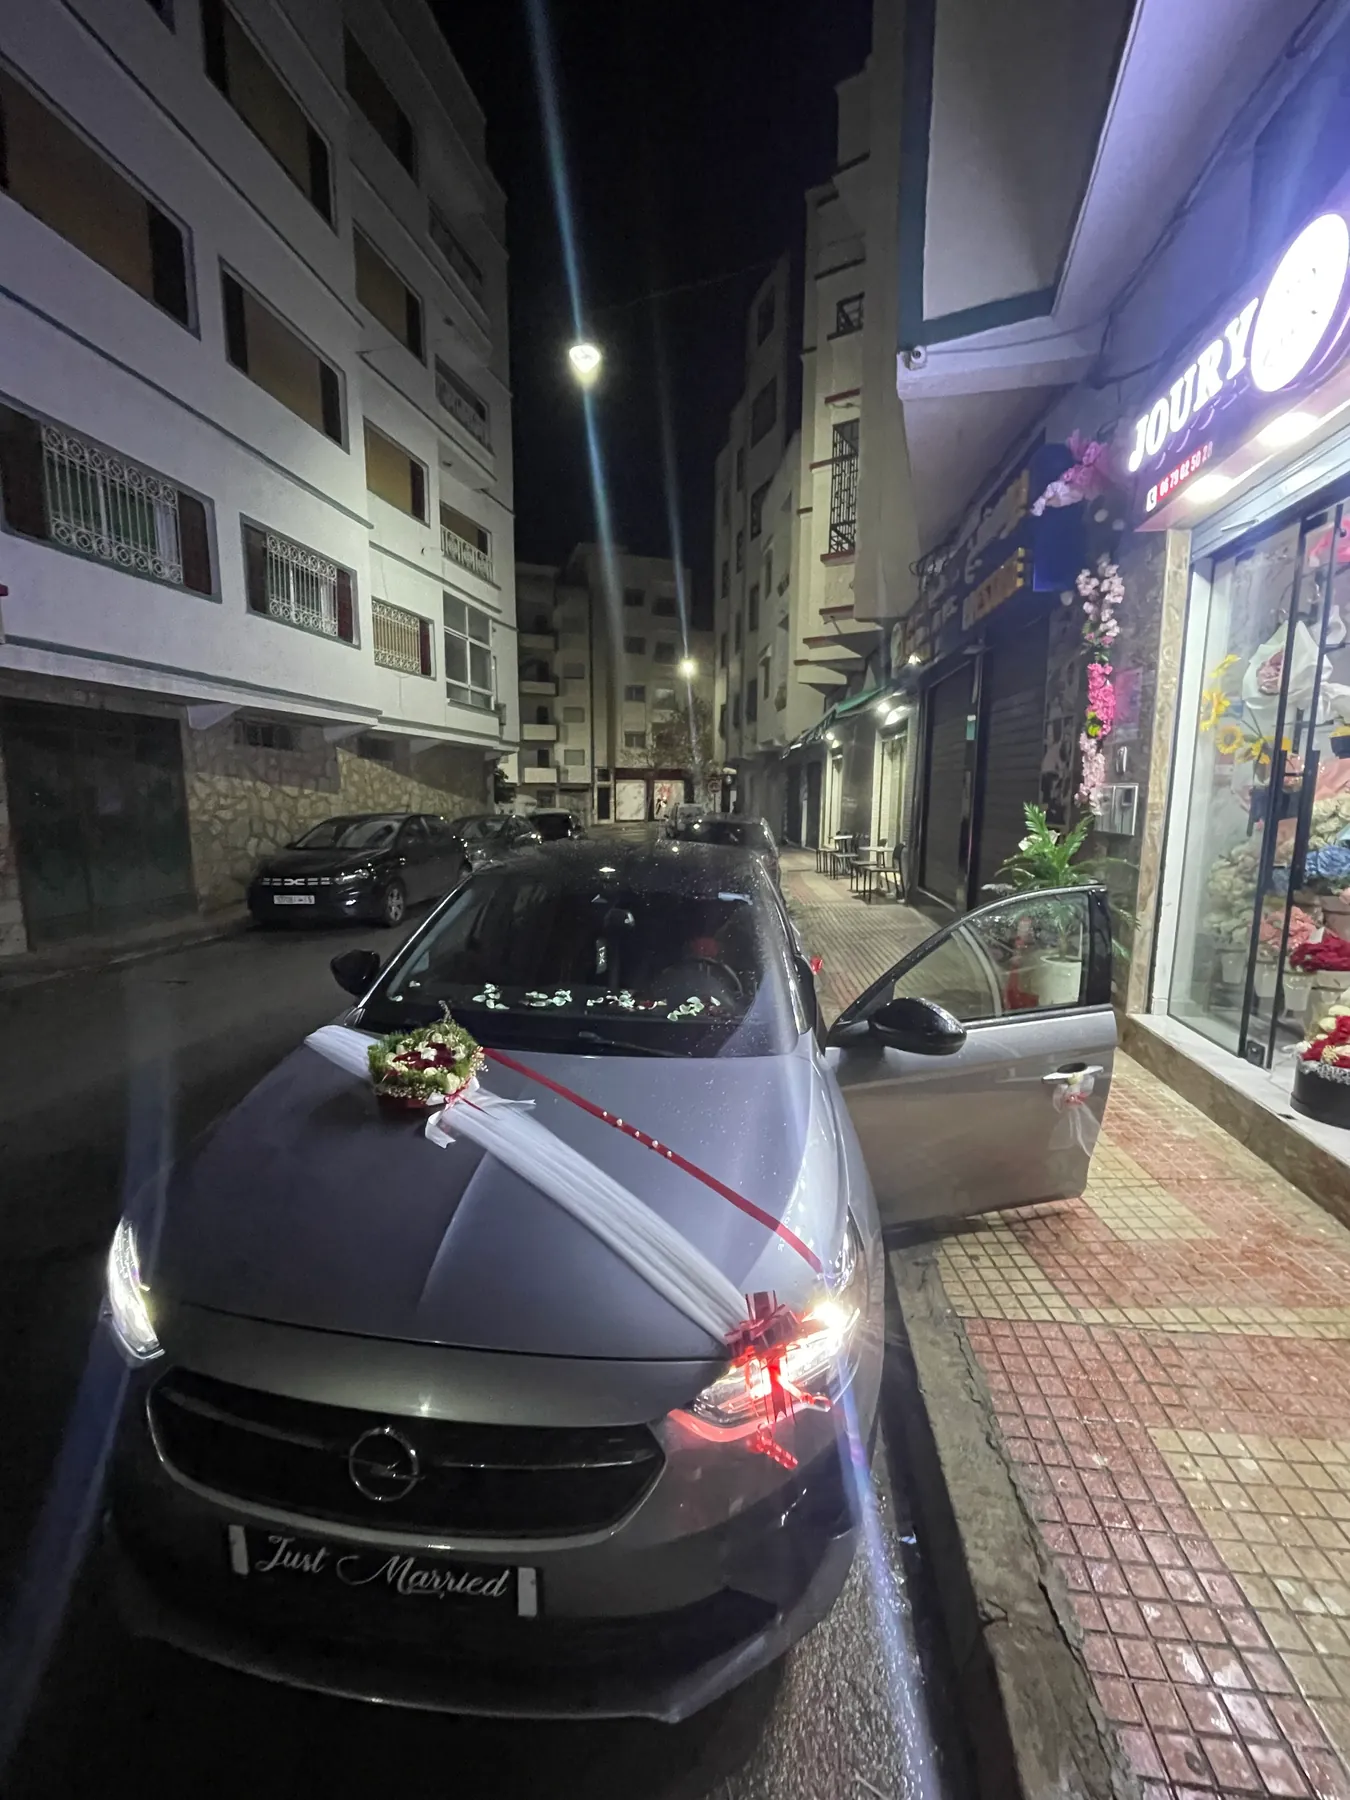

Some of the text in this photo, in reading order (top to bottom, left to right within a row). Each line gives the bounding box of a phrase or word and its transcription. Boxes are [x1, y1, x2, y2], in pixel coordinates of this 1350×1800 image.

[1128, 297, 1259, 472] JOURY
[255, 1535, 511, 1600] Just Married
